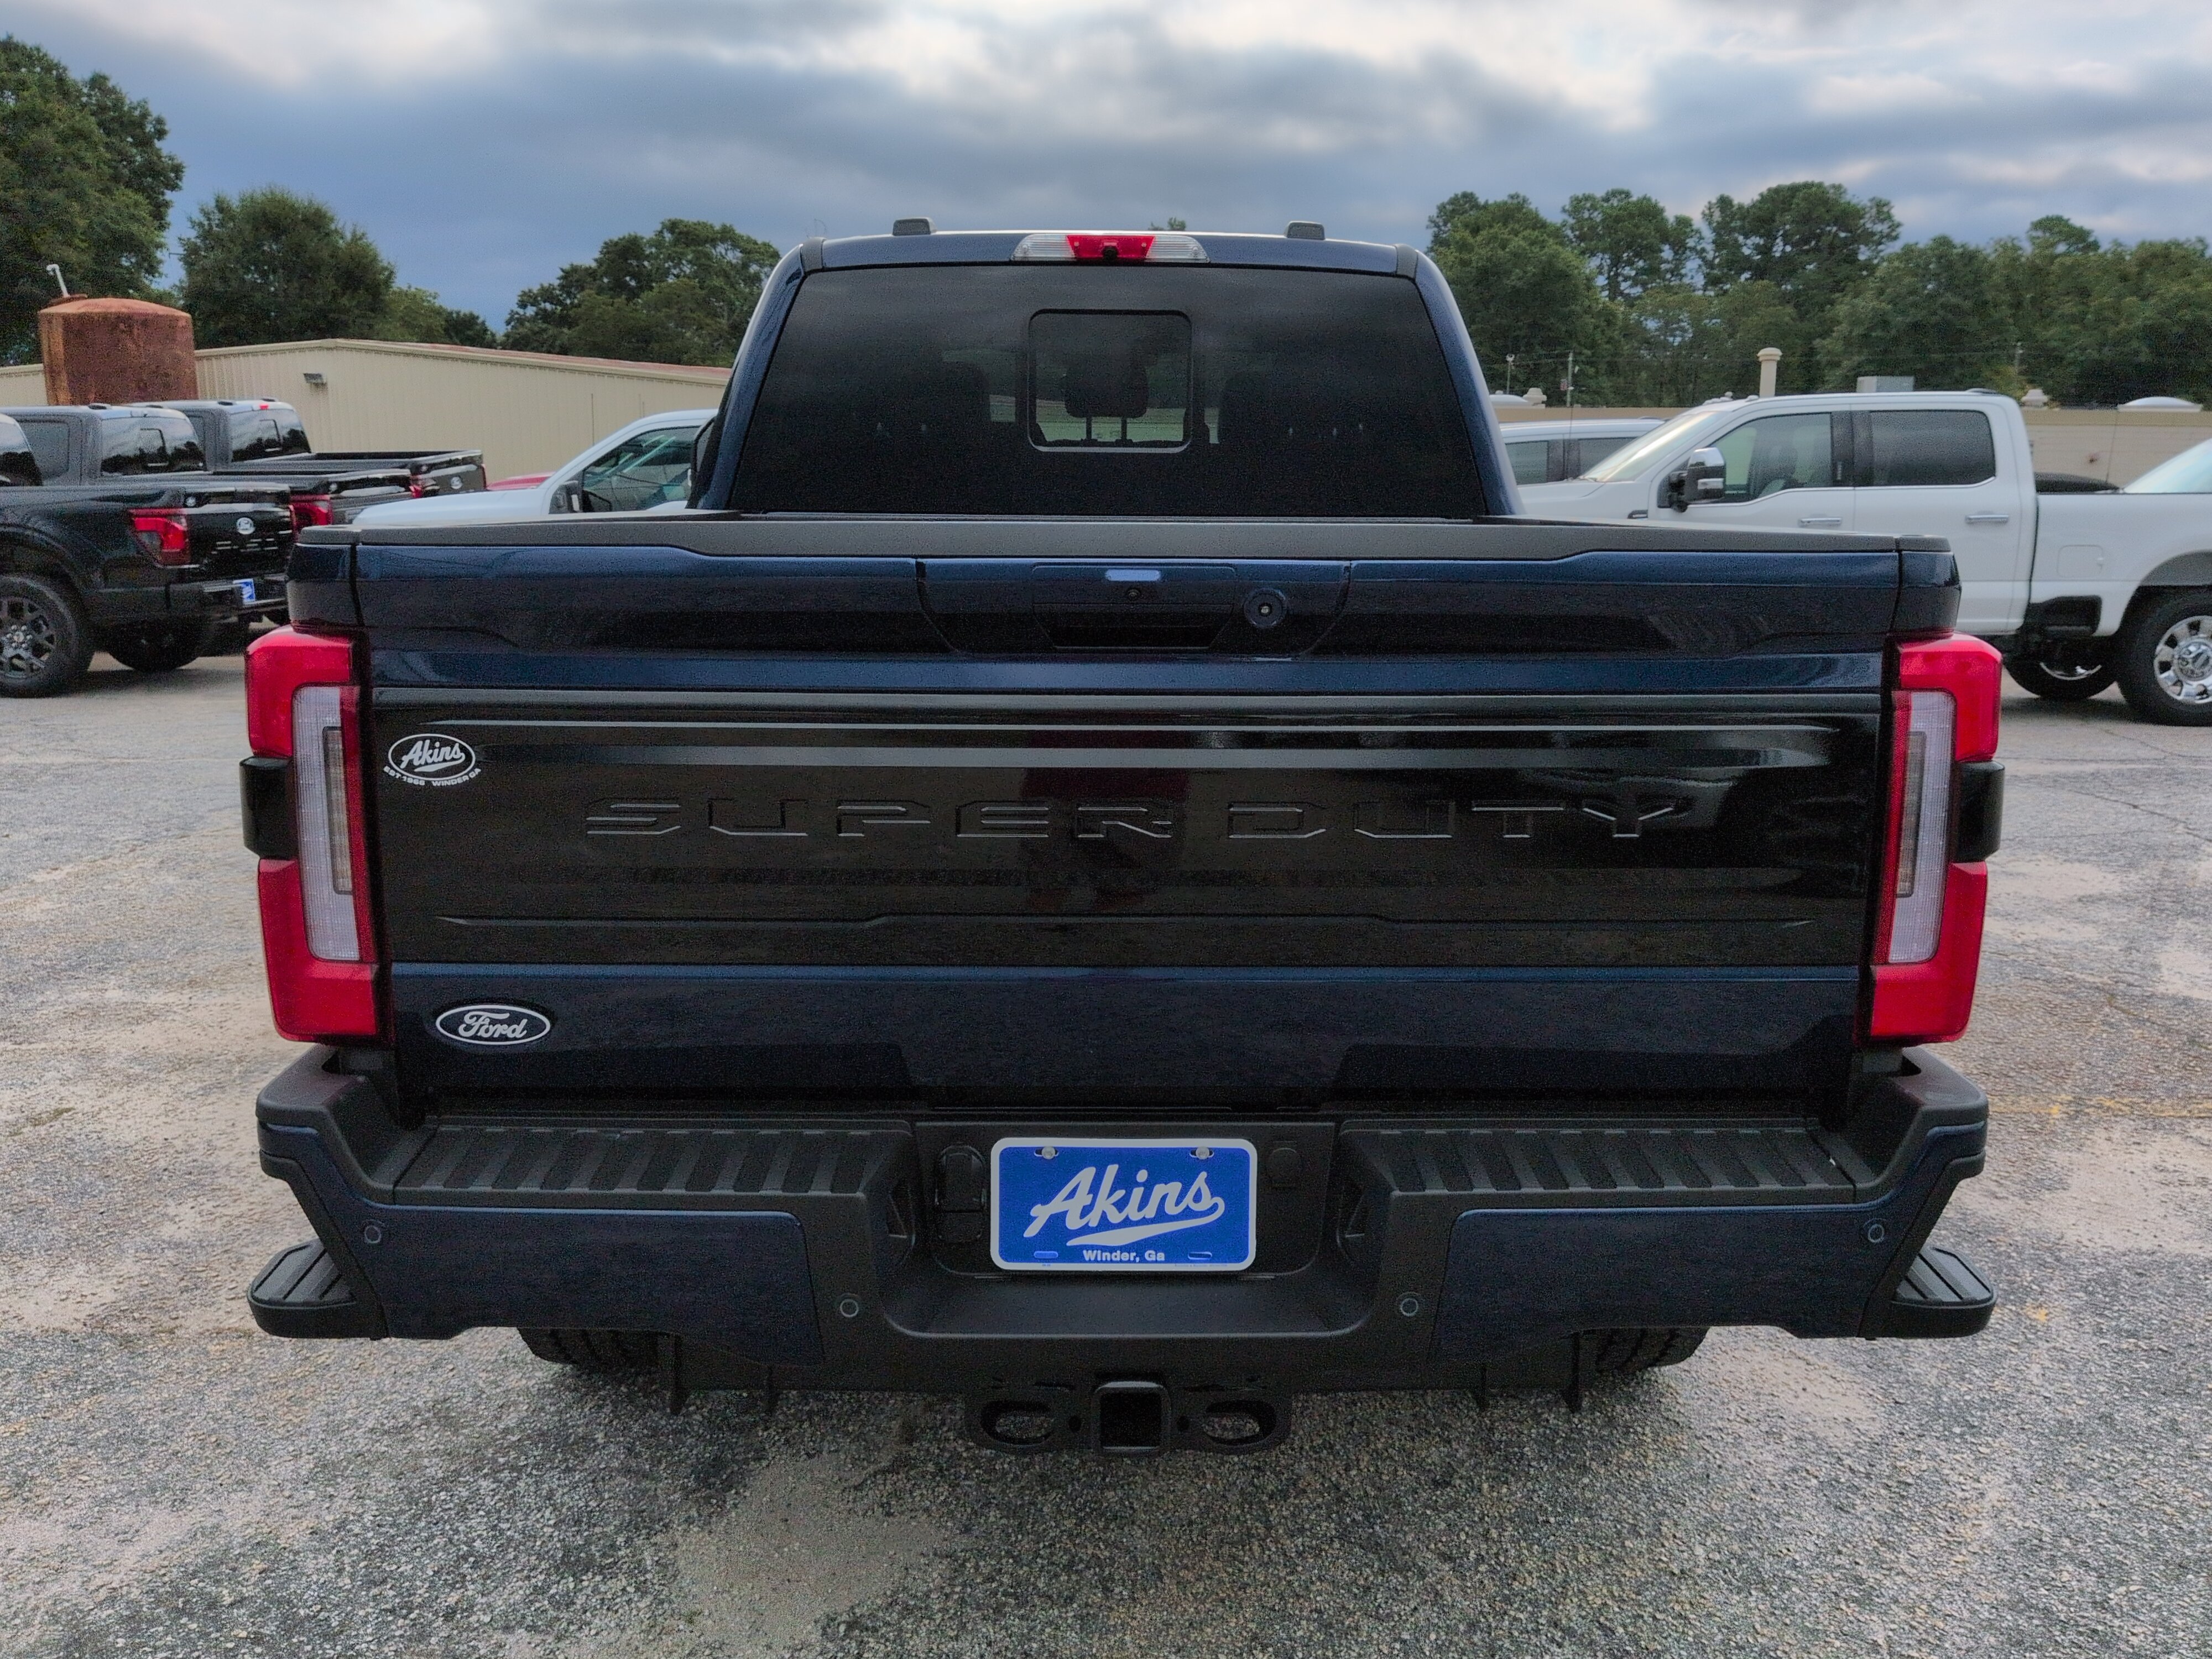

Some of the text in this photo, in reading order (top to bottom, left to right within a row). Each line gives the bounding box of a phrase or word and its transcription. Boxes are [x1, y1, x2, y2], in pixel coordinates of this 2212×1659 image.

[400, 739, 466, 772] Akins
[383, 765, 401, 779] EST
[432, 775, 469, 786] WINDER
[469, 768, 482, 778] GA
[584, 799, 1684, 838] SUPER DUTY
[458, 1011, 528, 1038] Ford
[1024, 1164, 1225, 1246] Akins
[1083, 1250, 1165, 1262] Winder, Ga
